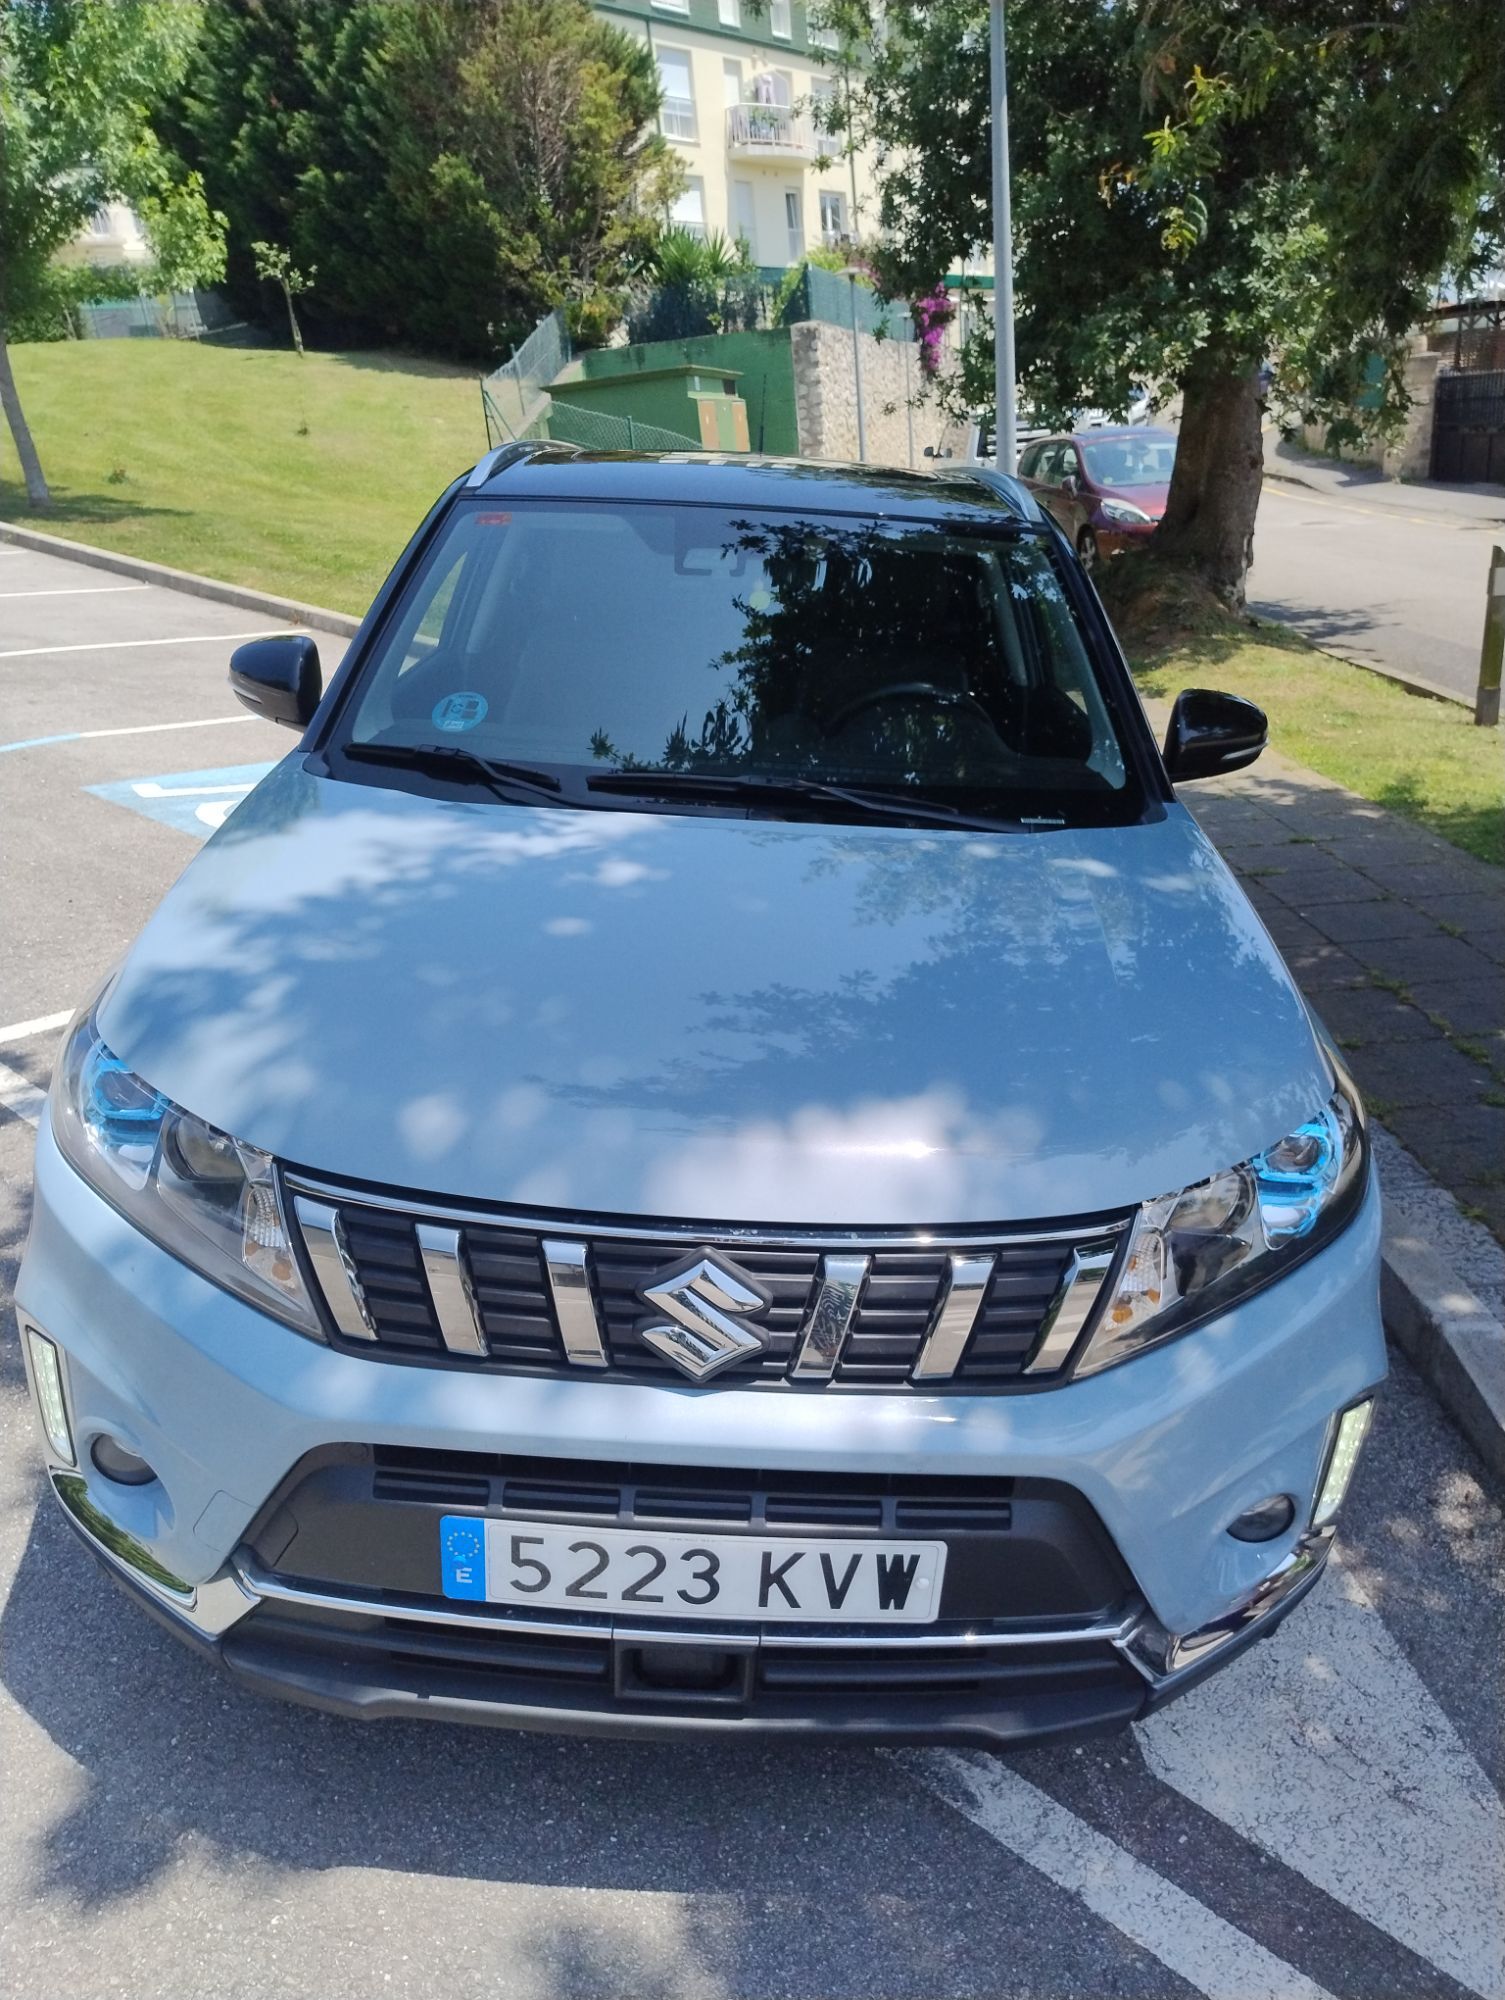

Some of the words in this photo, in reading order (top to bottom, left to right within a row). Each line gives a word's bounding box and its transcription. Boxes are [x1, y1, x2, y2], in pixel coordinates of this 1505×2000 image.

[455, 1567, 473, 1584] E
[508, 1534, 721, 1605] 5223
[757, 1550, 921, 1611] KVW
